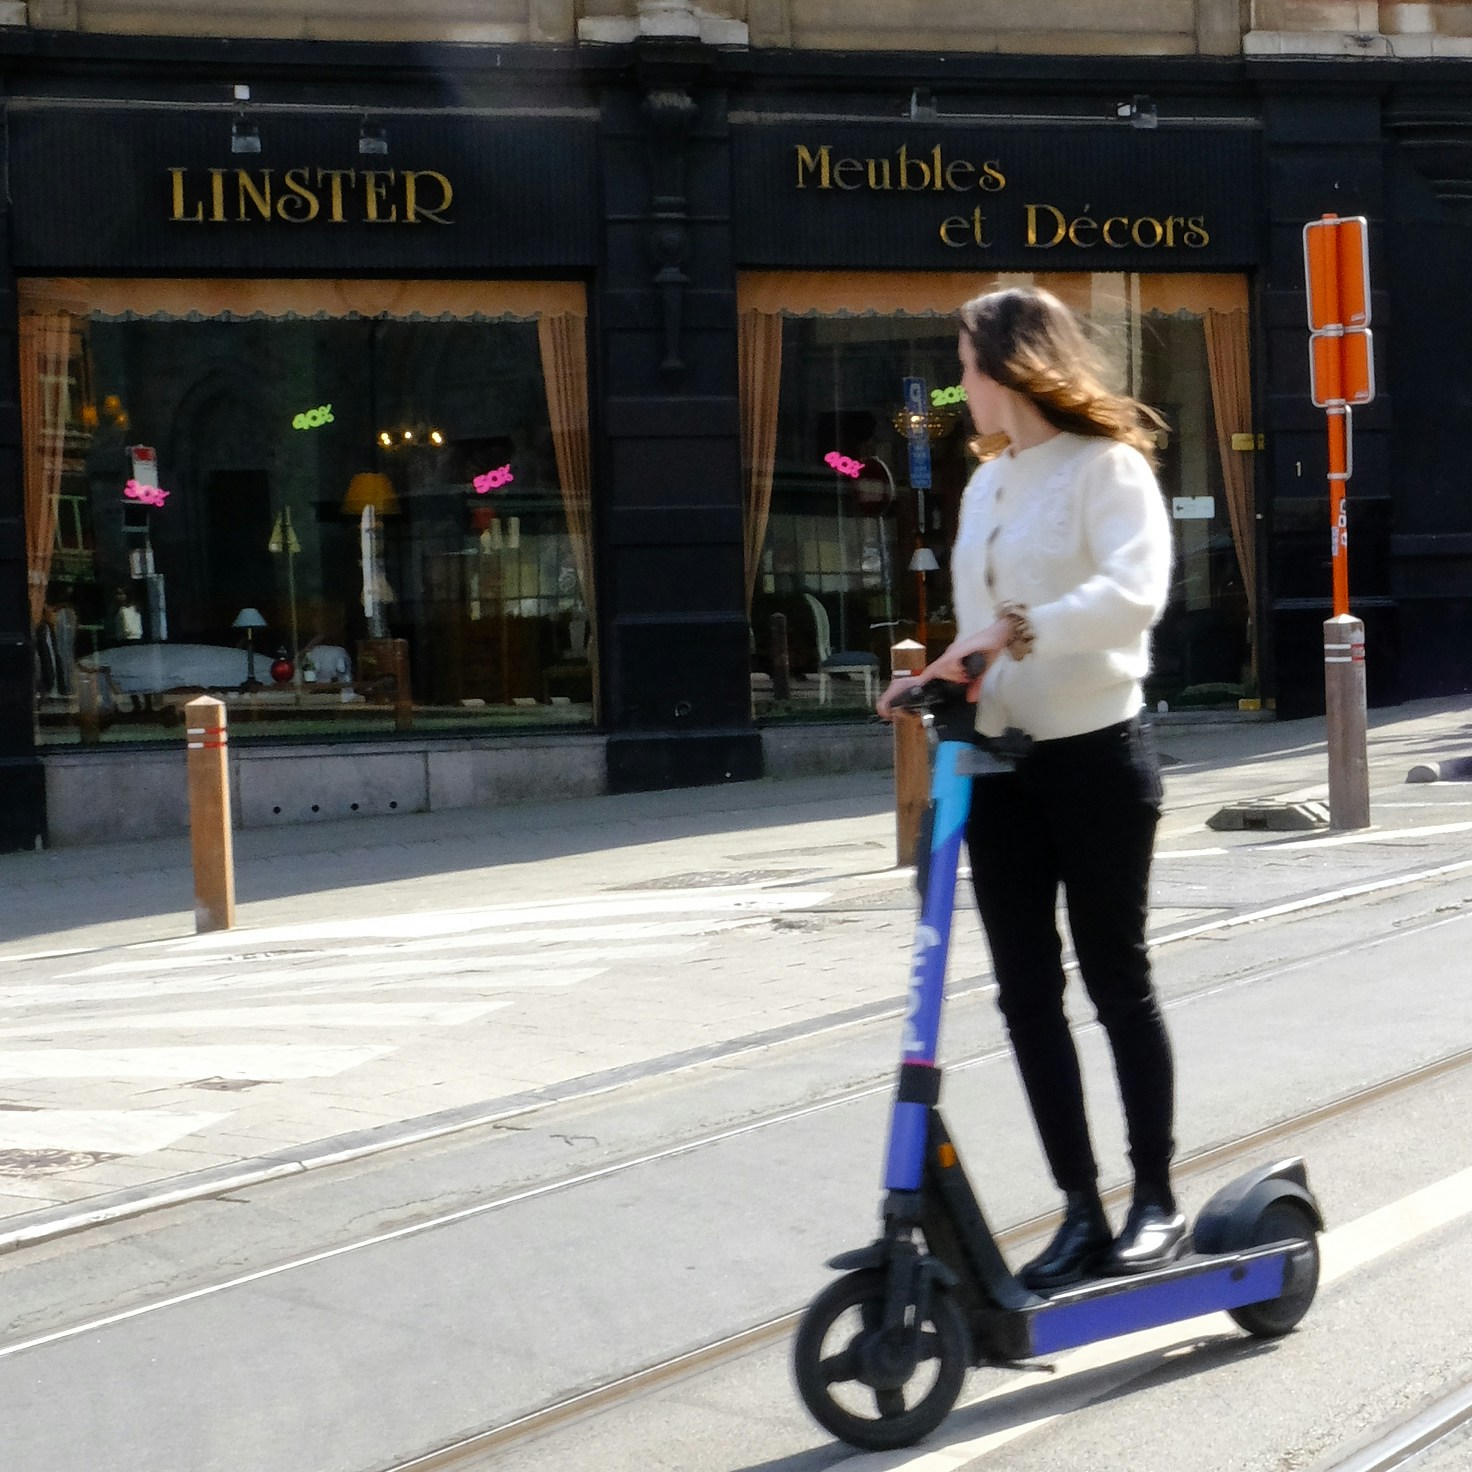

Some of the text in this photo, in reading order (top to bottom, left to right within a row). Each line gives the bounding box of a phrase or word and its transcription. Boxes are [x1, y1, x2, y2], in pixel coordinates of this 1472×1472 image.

[794, 142, 1007, 192] Meubles
[166, 166, 456, 225] LINSTER
[938, 202, 1211, 249] et Décors
